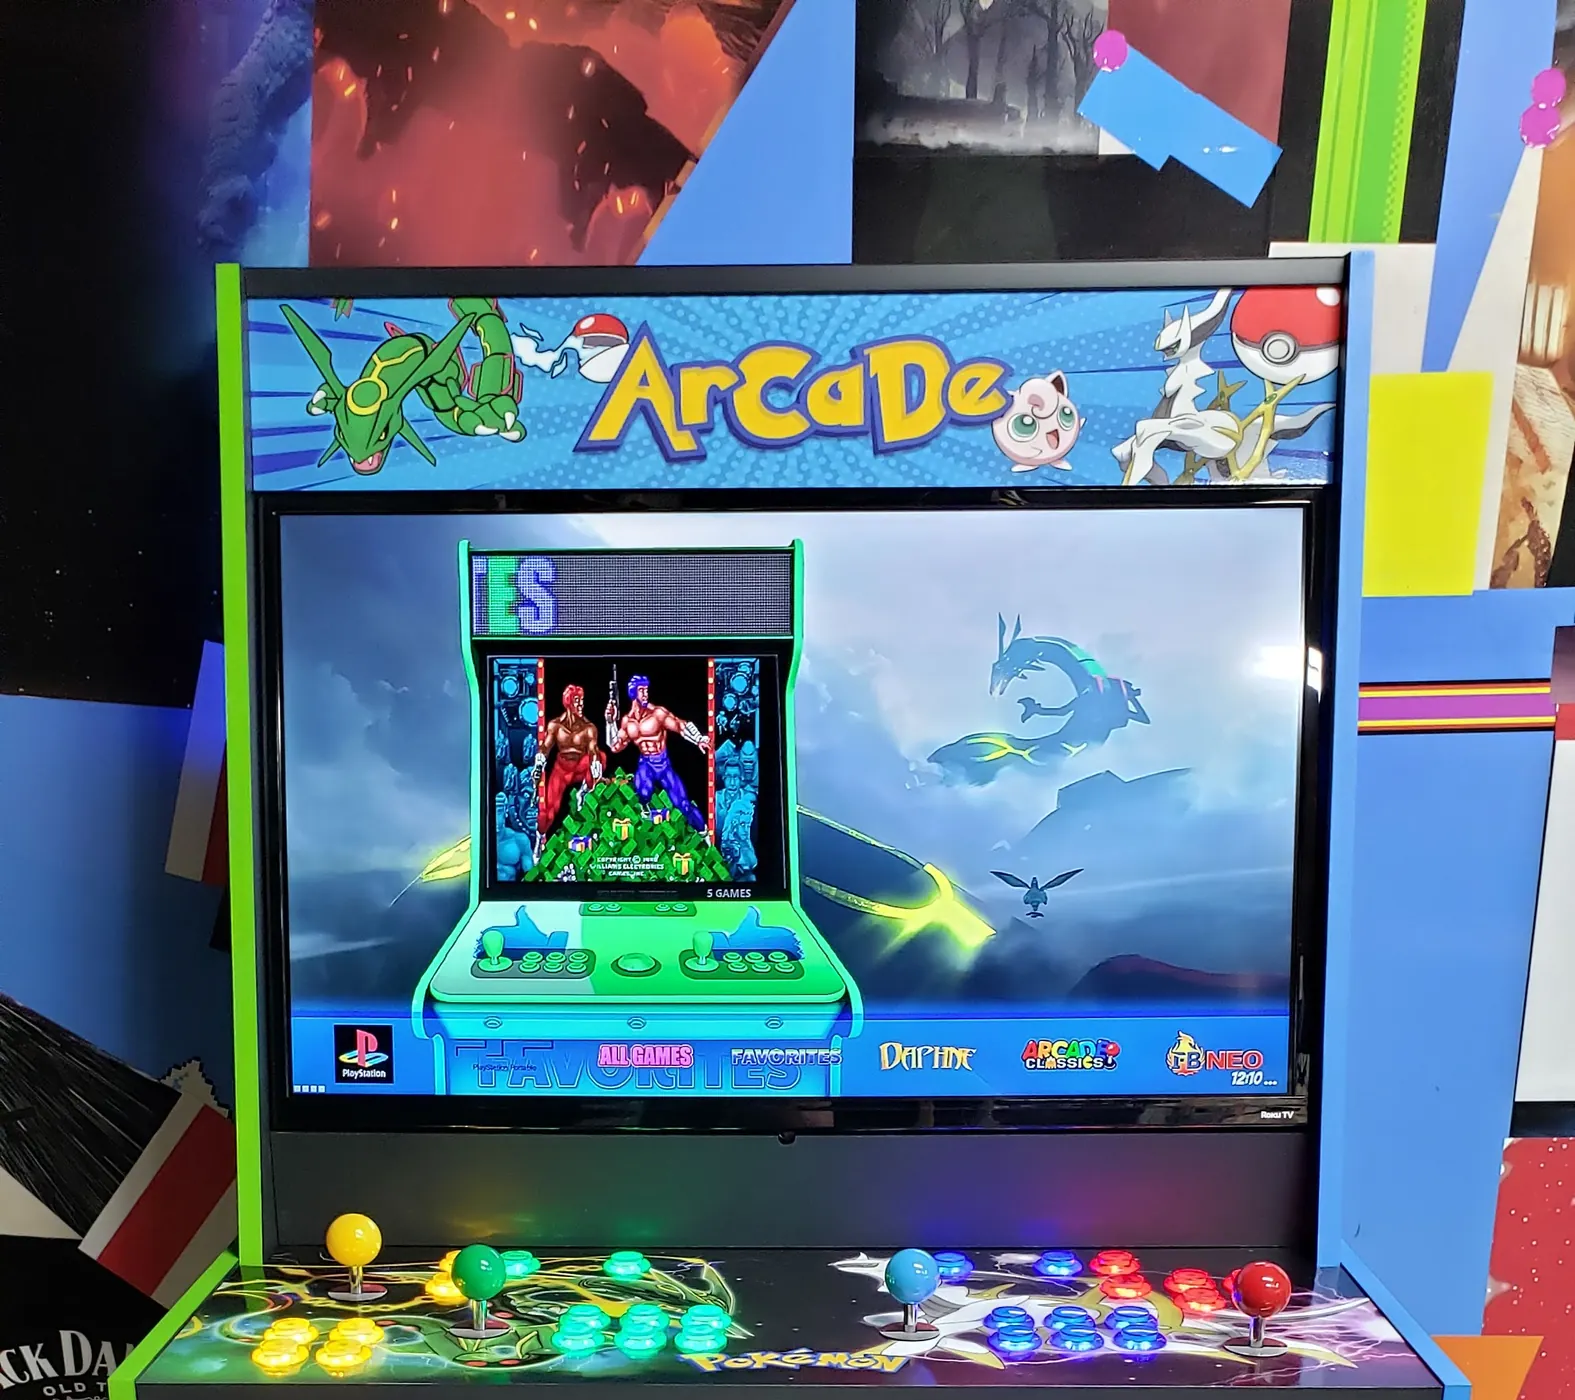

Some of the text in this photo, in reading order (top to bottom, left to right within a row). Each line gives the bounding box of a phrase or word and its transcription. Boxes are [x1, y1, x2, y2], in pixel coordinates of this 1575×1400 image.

[707, 889, 751, 898] 5 GAMES
[599, 1045, 694, 1067] ALL GAMES
[730, 1048, 843, 1065] FAVORITES
[1021, 1039, 1121, 1060] ARCADE
[1025, 1057, 1104, 1070] CLASSICS
[1206, 1050, 1264, 1070] NEO
[342, 1069, 387, 1079] PlayStation
[1261, 1111, 1294, 1119] Roku TV
[43, 1382, 86, 1396] OLD
